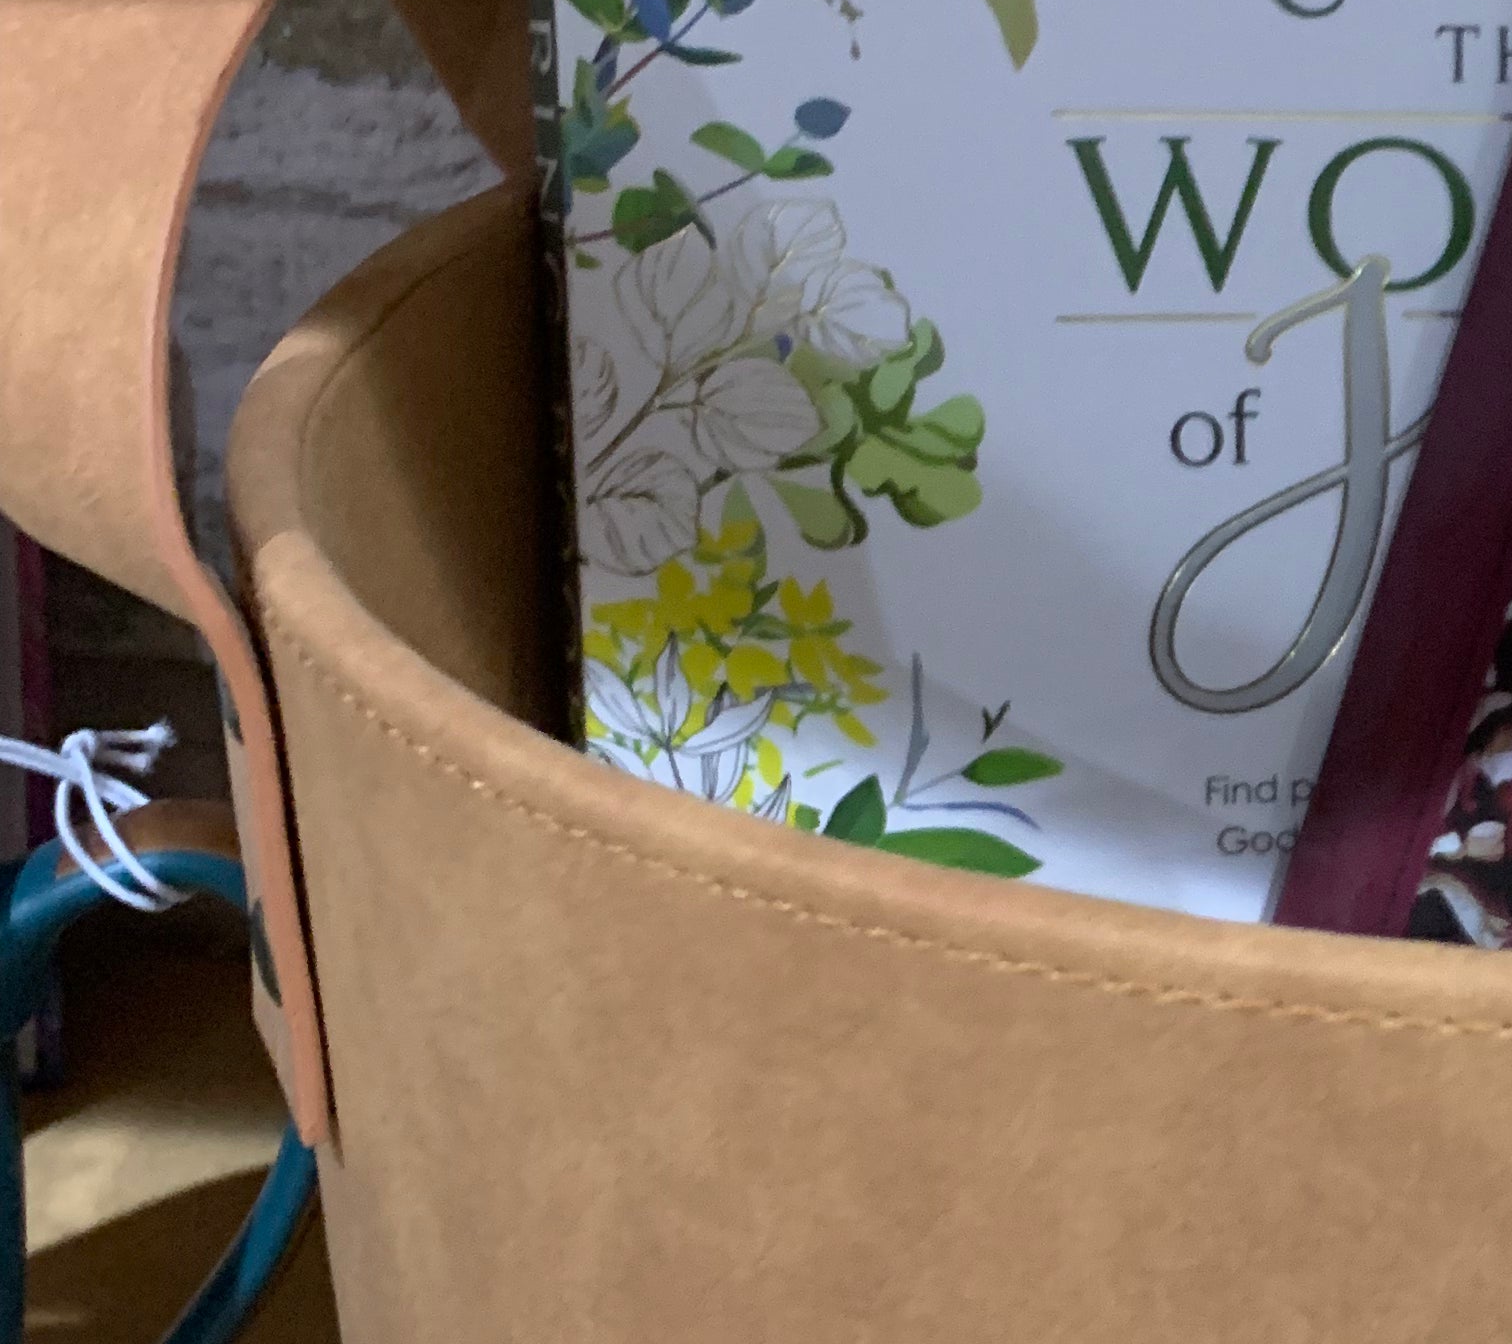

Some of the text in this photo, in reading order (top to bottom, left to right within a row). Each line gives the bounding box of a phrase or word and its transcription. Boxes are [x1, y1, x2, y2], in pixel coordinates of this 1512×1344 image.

[1065, 136, 1477, 294] WO
[1169, 388, 1261, 468] of
[1204, 773, 1279, 806] Find
